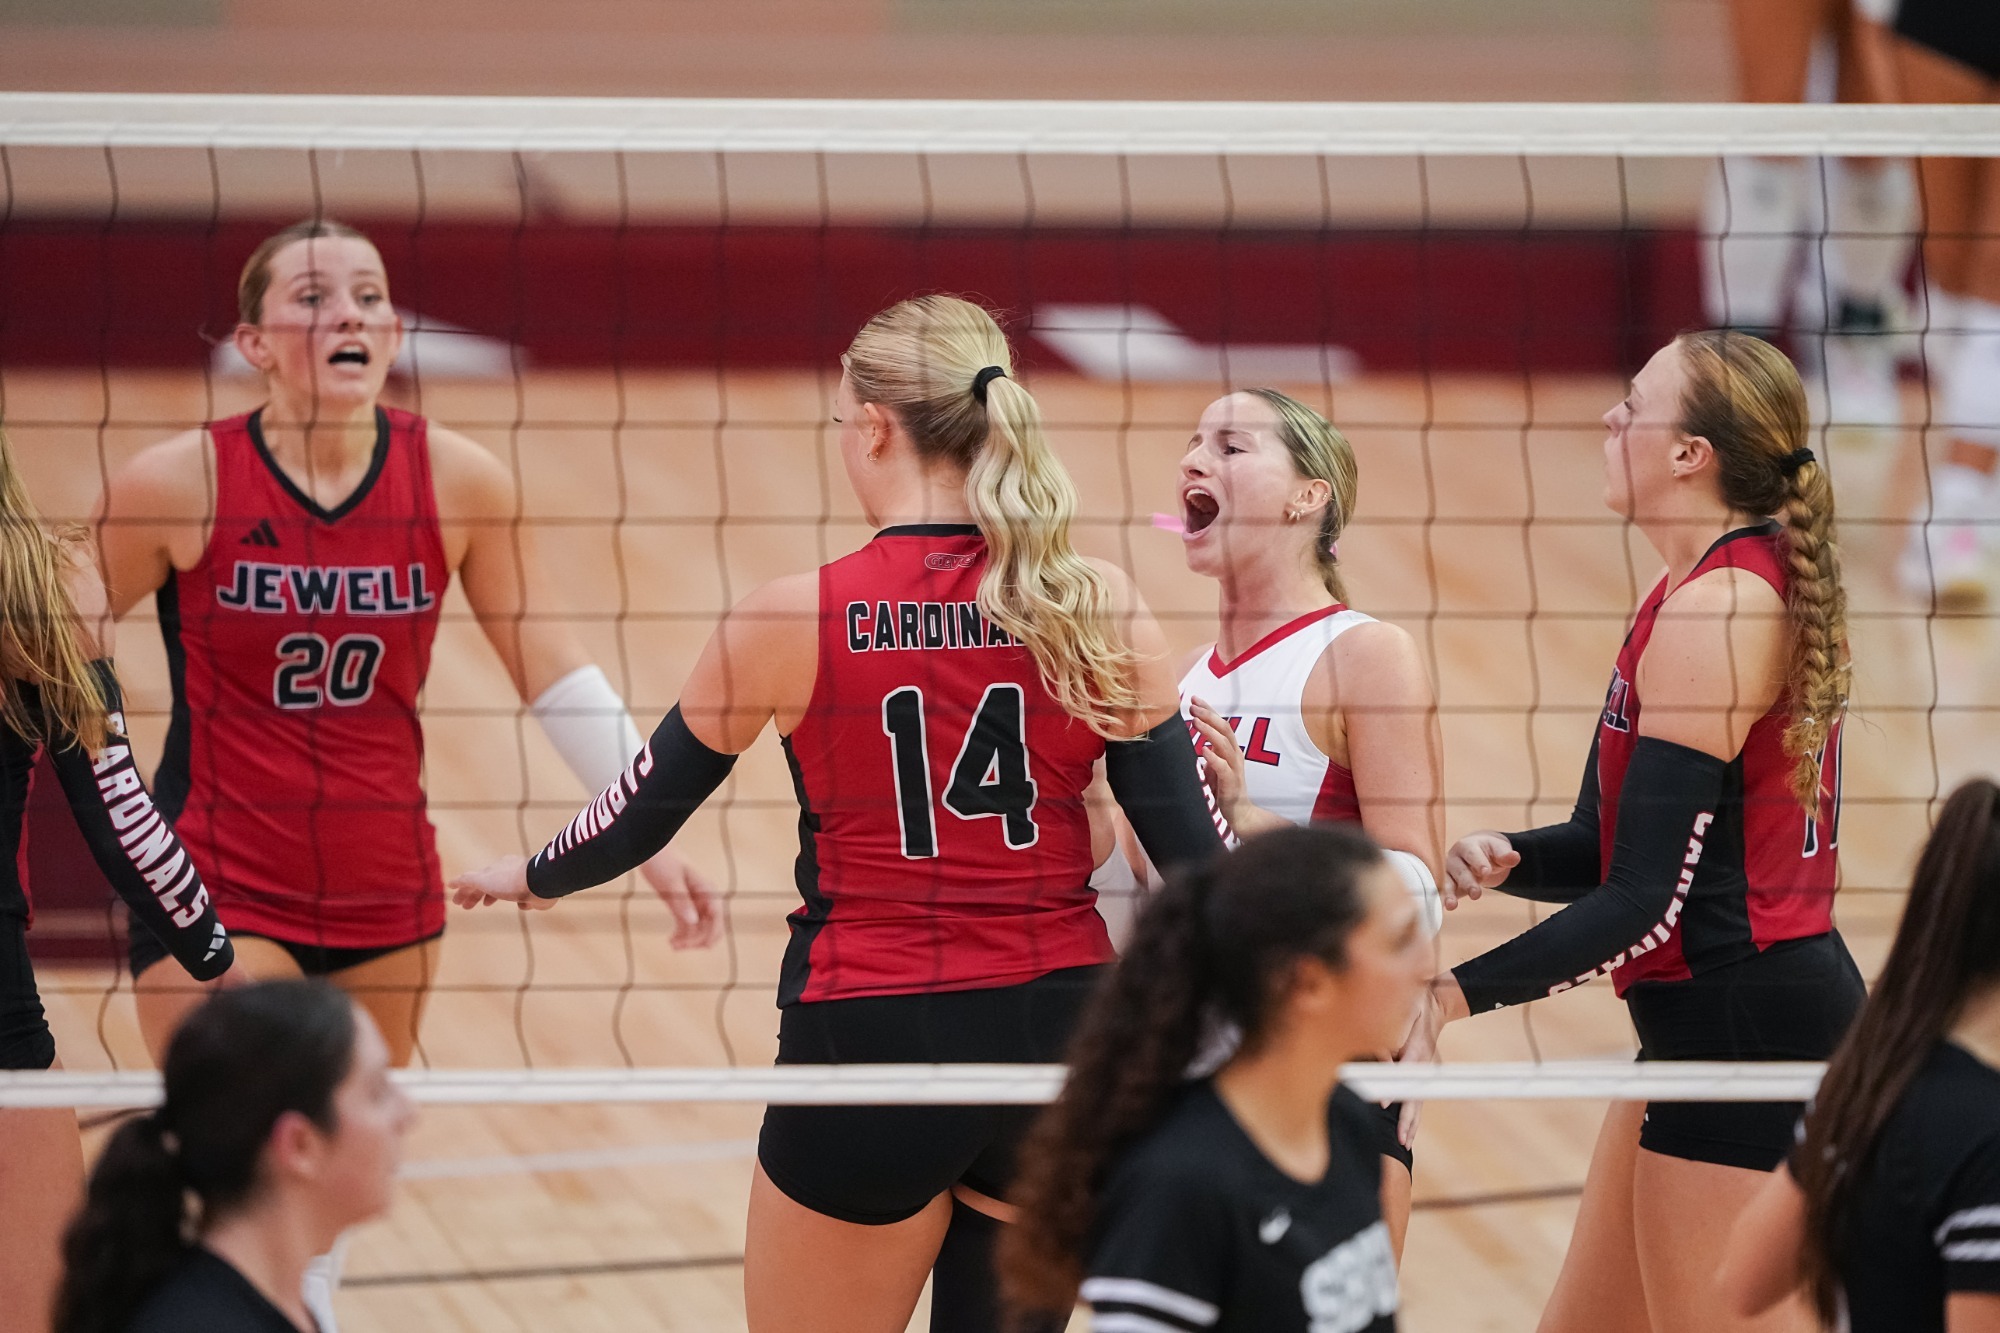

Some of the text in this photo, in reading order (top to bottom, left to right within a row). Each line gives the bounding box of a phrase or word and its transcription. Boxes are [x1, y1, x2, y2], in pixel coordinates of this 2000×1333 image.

[216, 560, 435, 615] JEWELL
[846, 600, 1028, 652] CARDINA
[273, 632, 385, 710] 20
[882, 682, 1039, 860] 14
